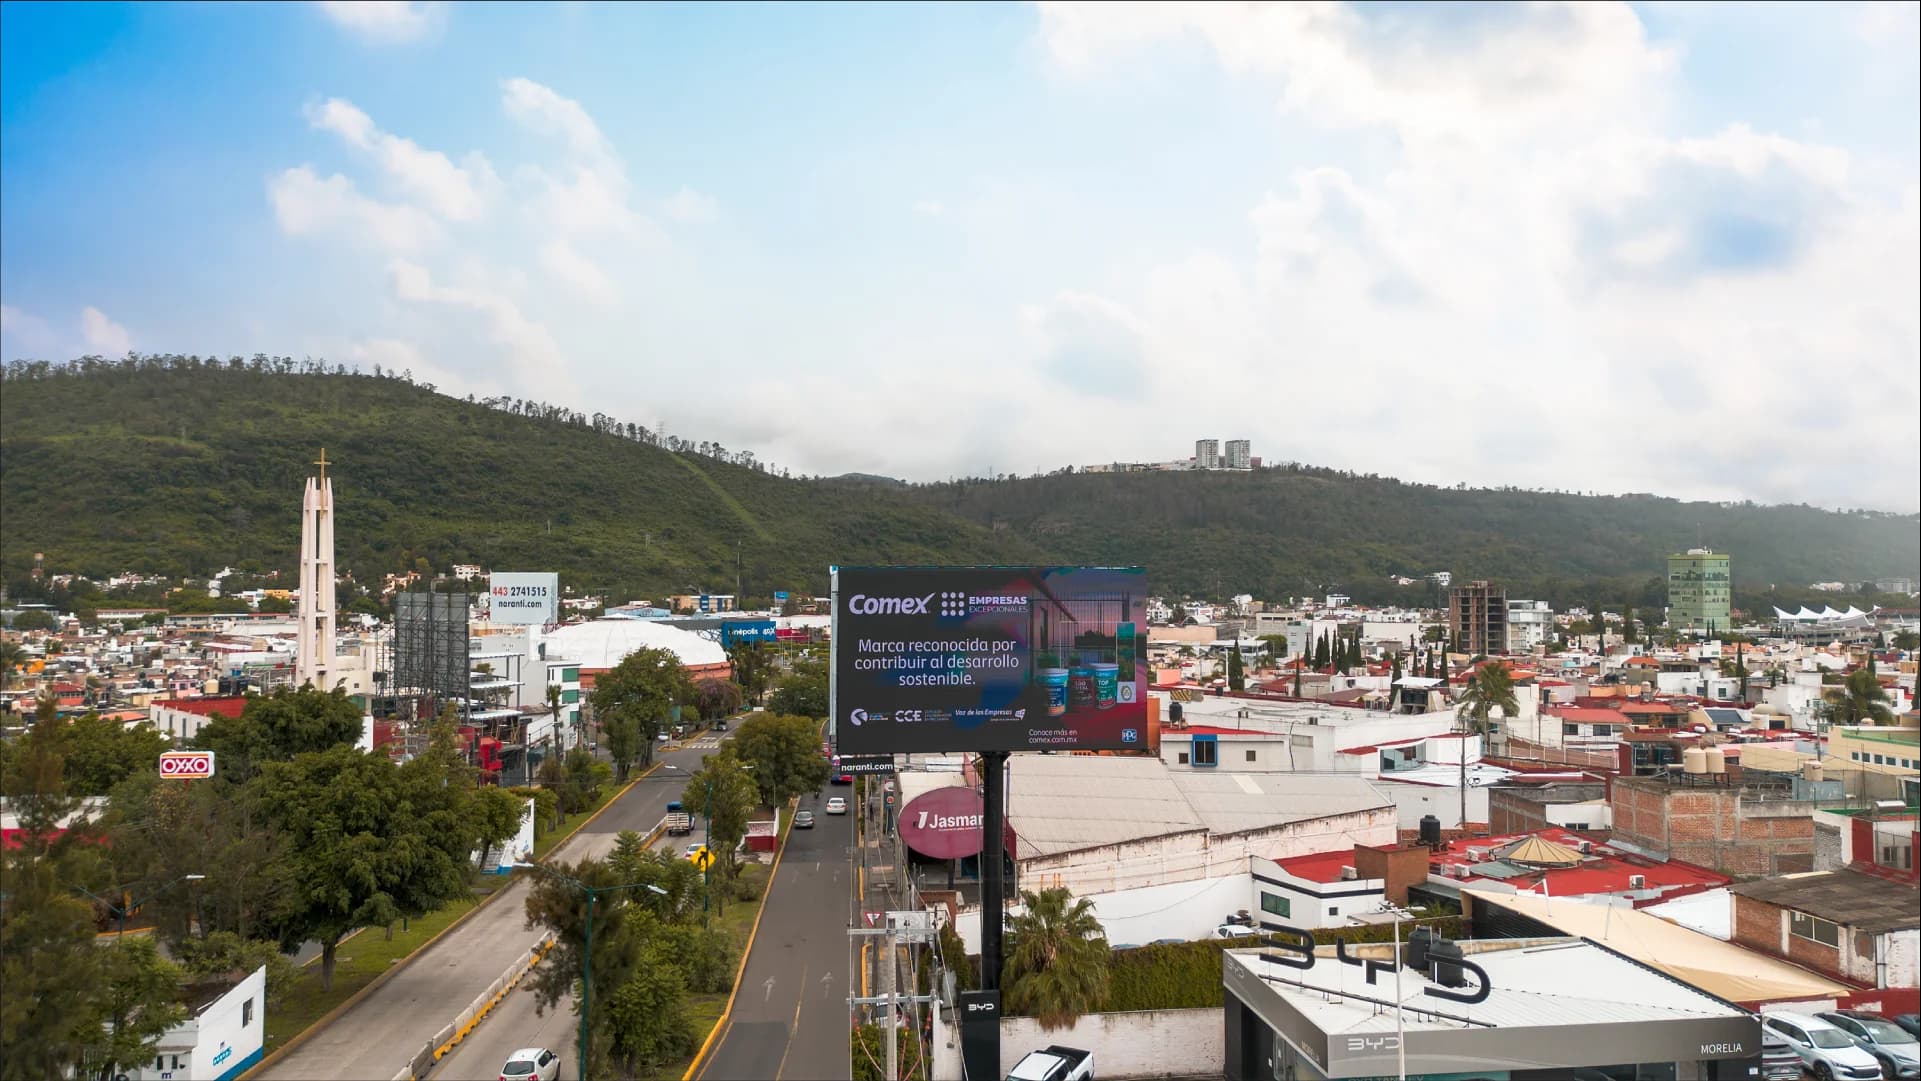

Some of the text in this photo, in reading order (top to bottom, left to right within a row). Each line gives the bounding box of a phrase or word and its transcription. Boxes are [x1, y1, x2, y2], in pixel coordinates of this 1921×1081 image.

[493, 586, 547, 597] 443 2741515
[498, 599, 542, 608] naranti.com
[849, 592, 936, 615] Comex
[969, 596, 1028, 605] EMPRESAS
[969, 605, 1028, 613] EXCEPCIONALES
[858, 637, 1017, 654] Marca reconocida por
[854, 654, 1019, 670] contribuir al desarrollo
[899, 672, 976, 686] sostenible.
[895, 710, 923, 722] CCE
[1053, 728, 1068, 736] más
[162, 757, 208, 773] OXXO
[841, 762, 894, 771] naranti.com
[1259, 921, 1491, 1004] BYD
[968, 1003, 995, 1011] BYD
[1347, 1037, 1401, 1051] BYD
[1700, 1043, 1743, 1055] MORELIA
